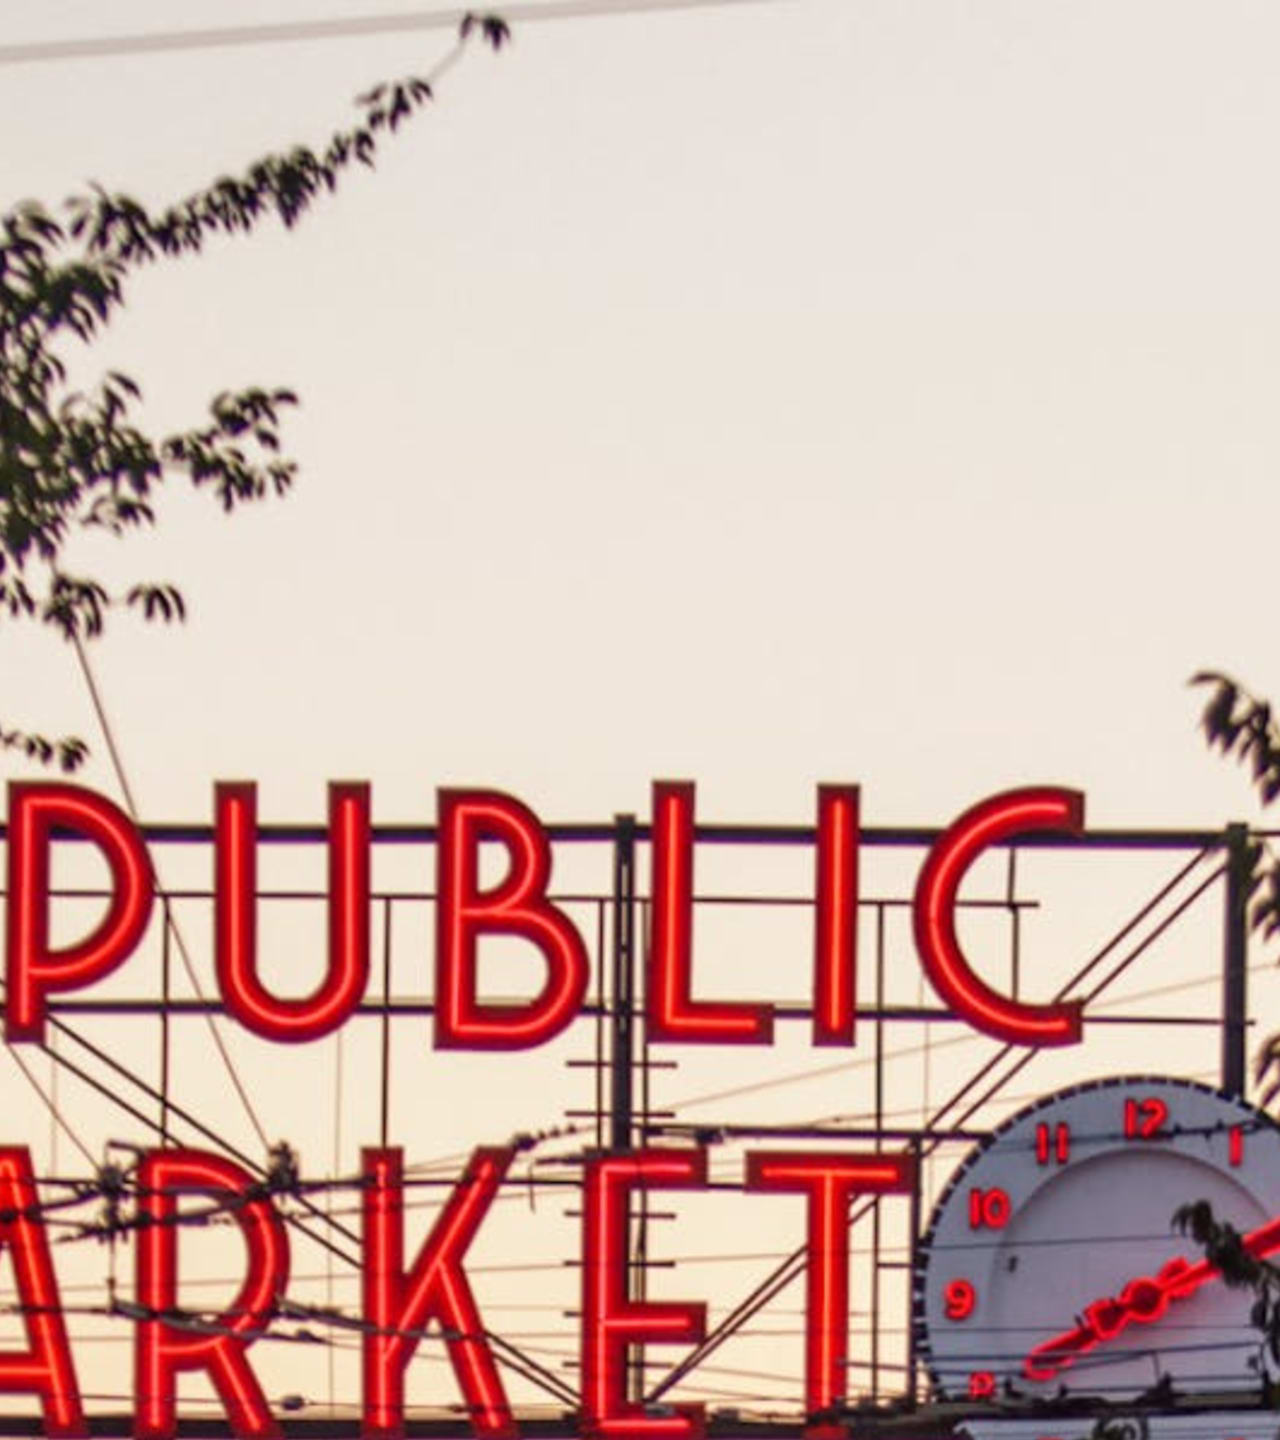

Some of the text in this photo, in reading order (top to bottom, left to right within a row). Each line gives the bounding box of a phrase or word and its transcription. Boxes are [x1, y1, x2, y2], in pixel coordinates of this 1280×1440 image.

[4, 780, 1086, 1050] PUBLIC
[1124, 1097, 1170, 1140] 12
[1035, 1122, 1071, 1164] 11
[1226, 1125, 1245, 1167] 1
[969, 1187, 1012, 1229] 10
[943, 1279, 977, 1320] 9
